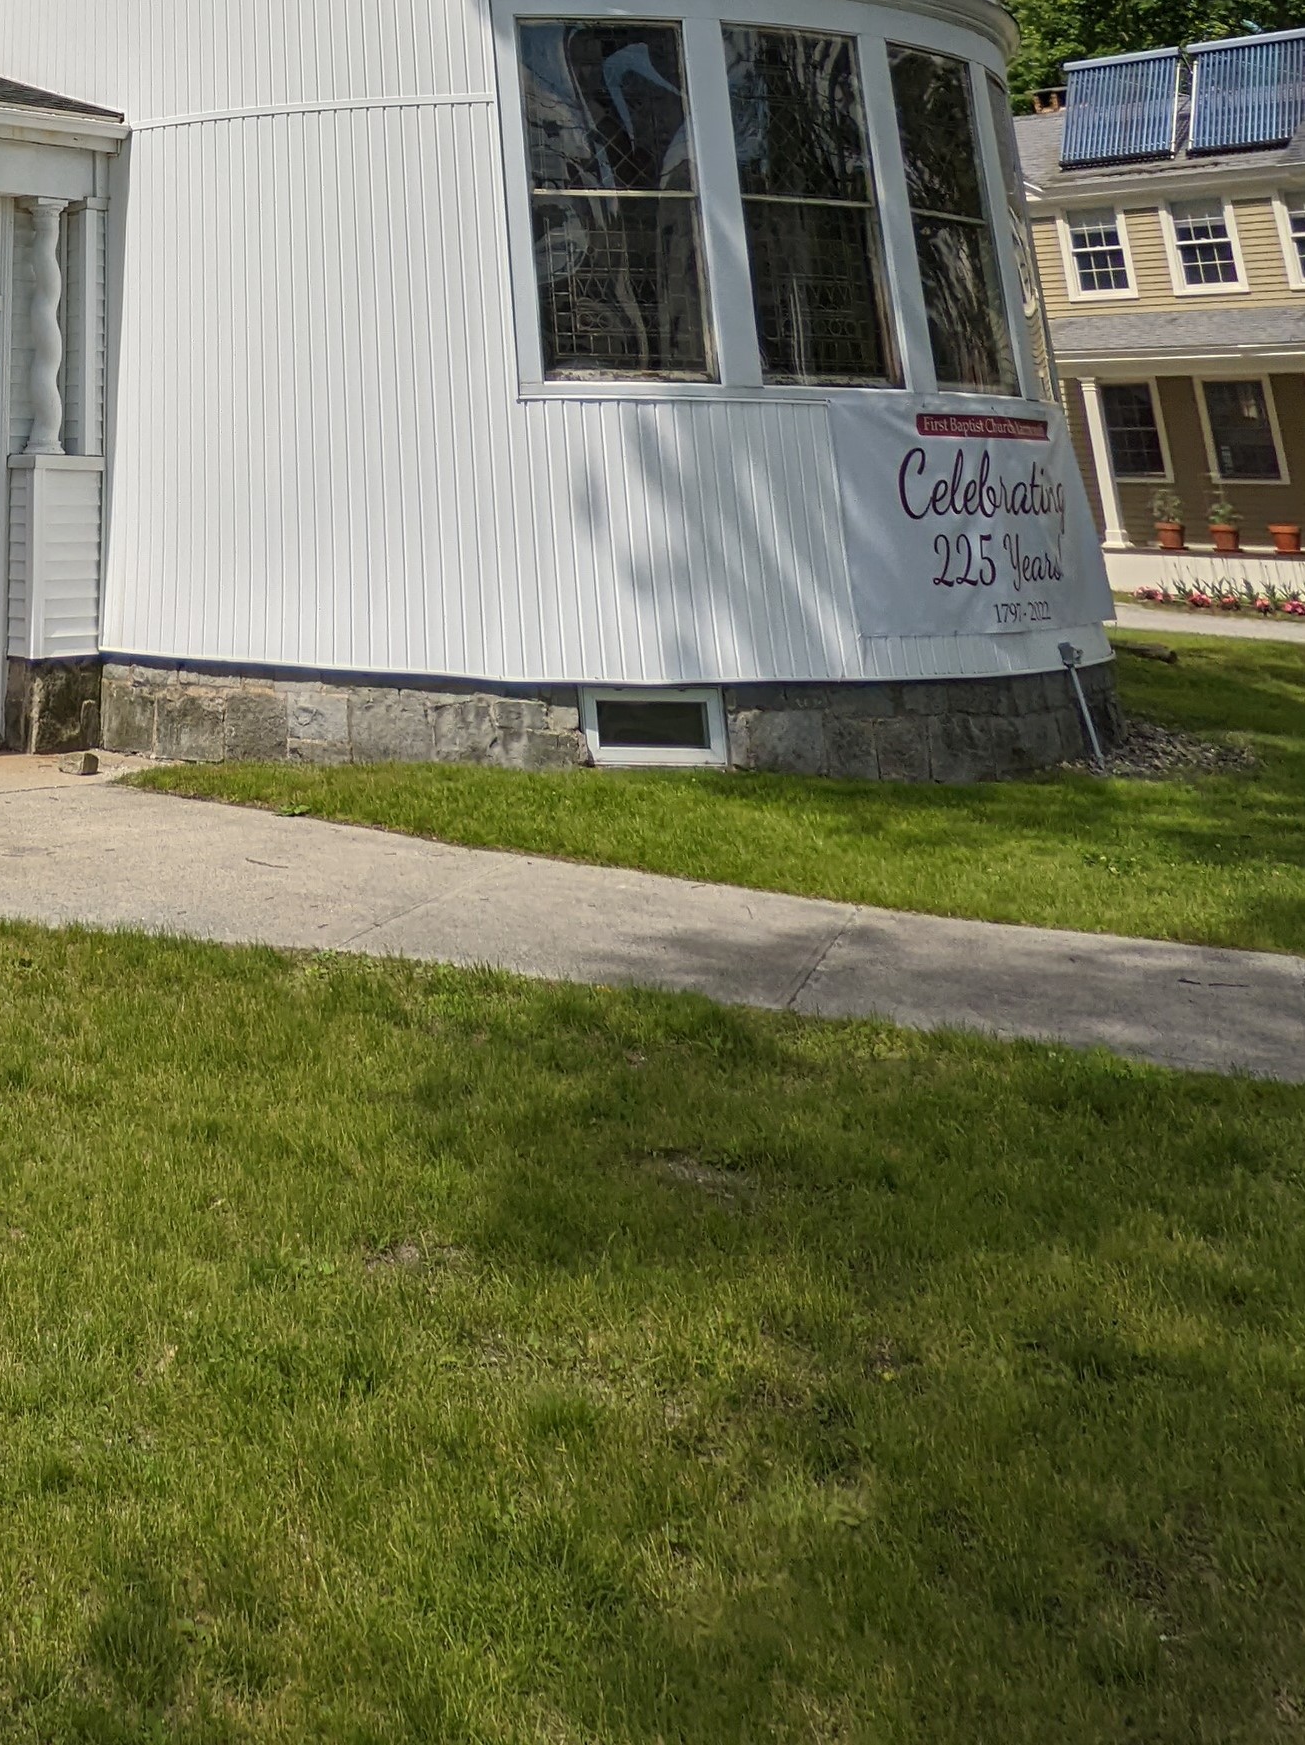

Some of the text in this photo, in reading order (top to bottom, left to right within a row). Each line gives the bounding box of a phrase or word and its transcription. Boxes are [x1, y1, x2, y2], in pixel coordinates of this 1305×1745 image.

[923, 416, 948, 432] First
[950, 417, 984, 437] Baptist
[898, 447, 1065, 534] Celebrating
[933, 534, 996, 587] 225
